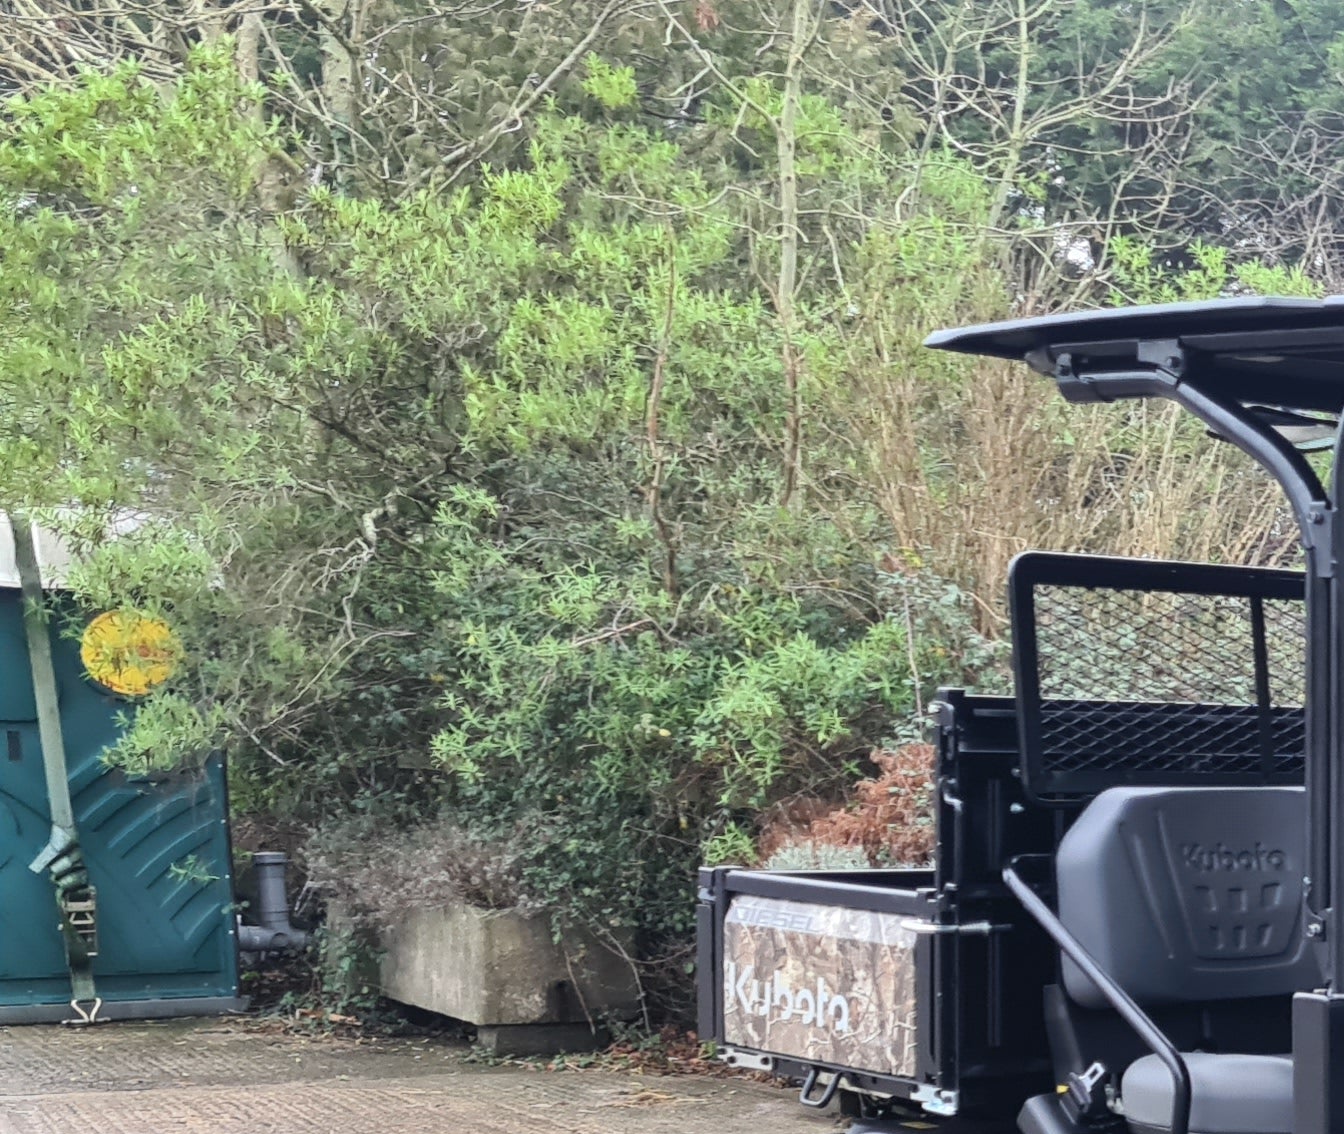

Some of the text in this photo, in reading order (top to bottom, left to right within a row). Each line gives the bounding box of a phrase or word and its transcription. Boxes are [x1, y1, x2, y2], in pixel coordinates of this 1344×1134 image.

[1183, 842, 1288, 871] Kubota
[733, 905, 821, 934] DIESEL
[726, 960, 849, 1033] Kubota
